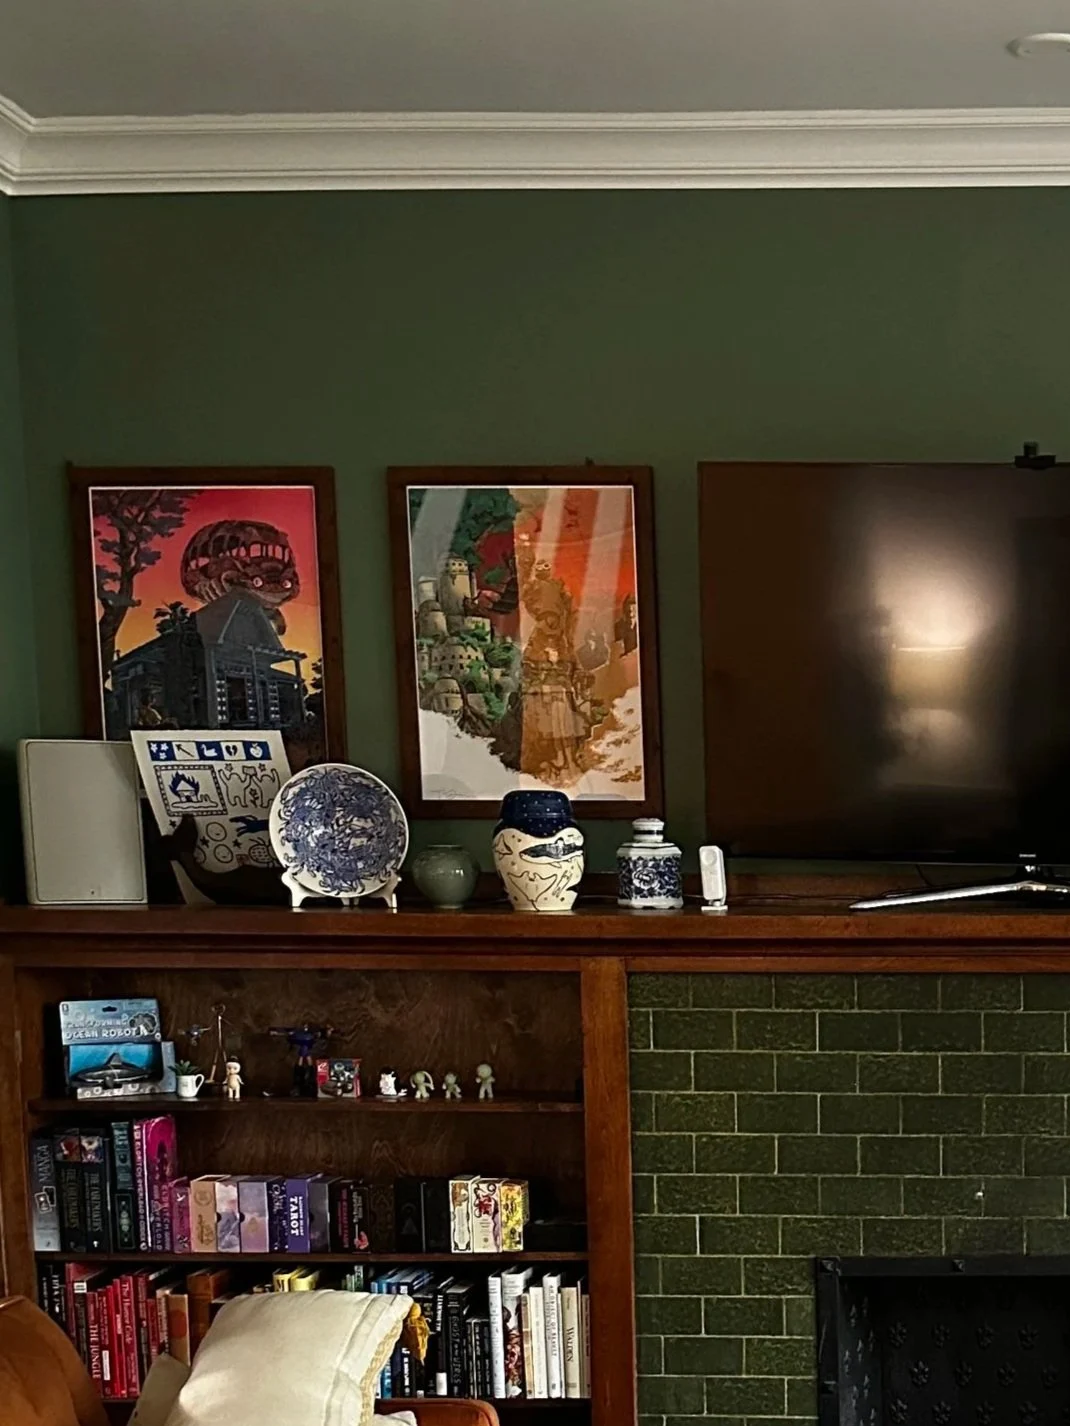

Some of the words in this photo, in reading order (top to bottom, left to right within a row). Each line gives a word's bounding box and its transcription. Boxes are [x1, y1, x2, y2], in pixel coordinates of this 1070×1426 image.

[65, 1029, 99, 1039] OCEAN
[102, 1028, 137, 1038] ROBOT
[135, 1141, 143, 1177] ELDRITCH
[137, 1178, 145, 1213] OVERLOAD
[290, 1196, 299, 1237] TAROT
[122, 1282, 130, 1297] The
[90, 1323, 99, 1342] THE
[452, 1316, 460, 1342] GHOST
[566, 1327, 575, 1363] WALDEN
[90, 1344, 101, 1379] JUNGLE
